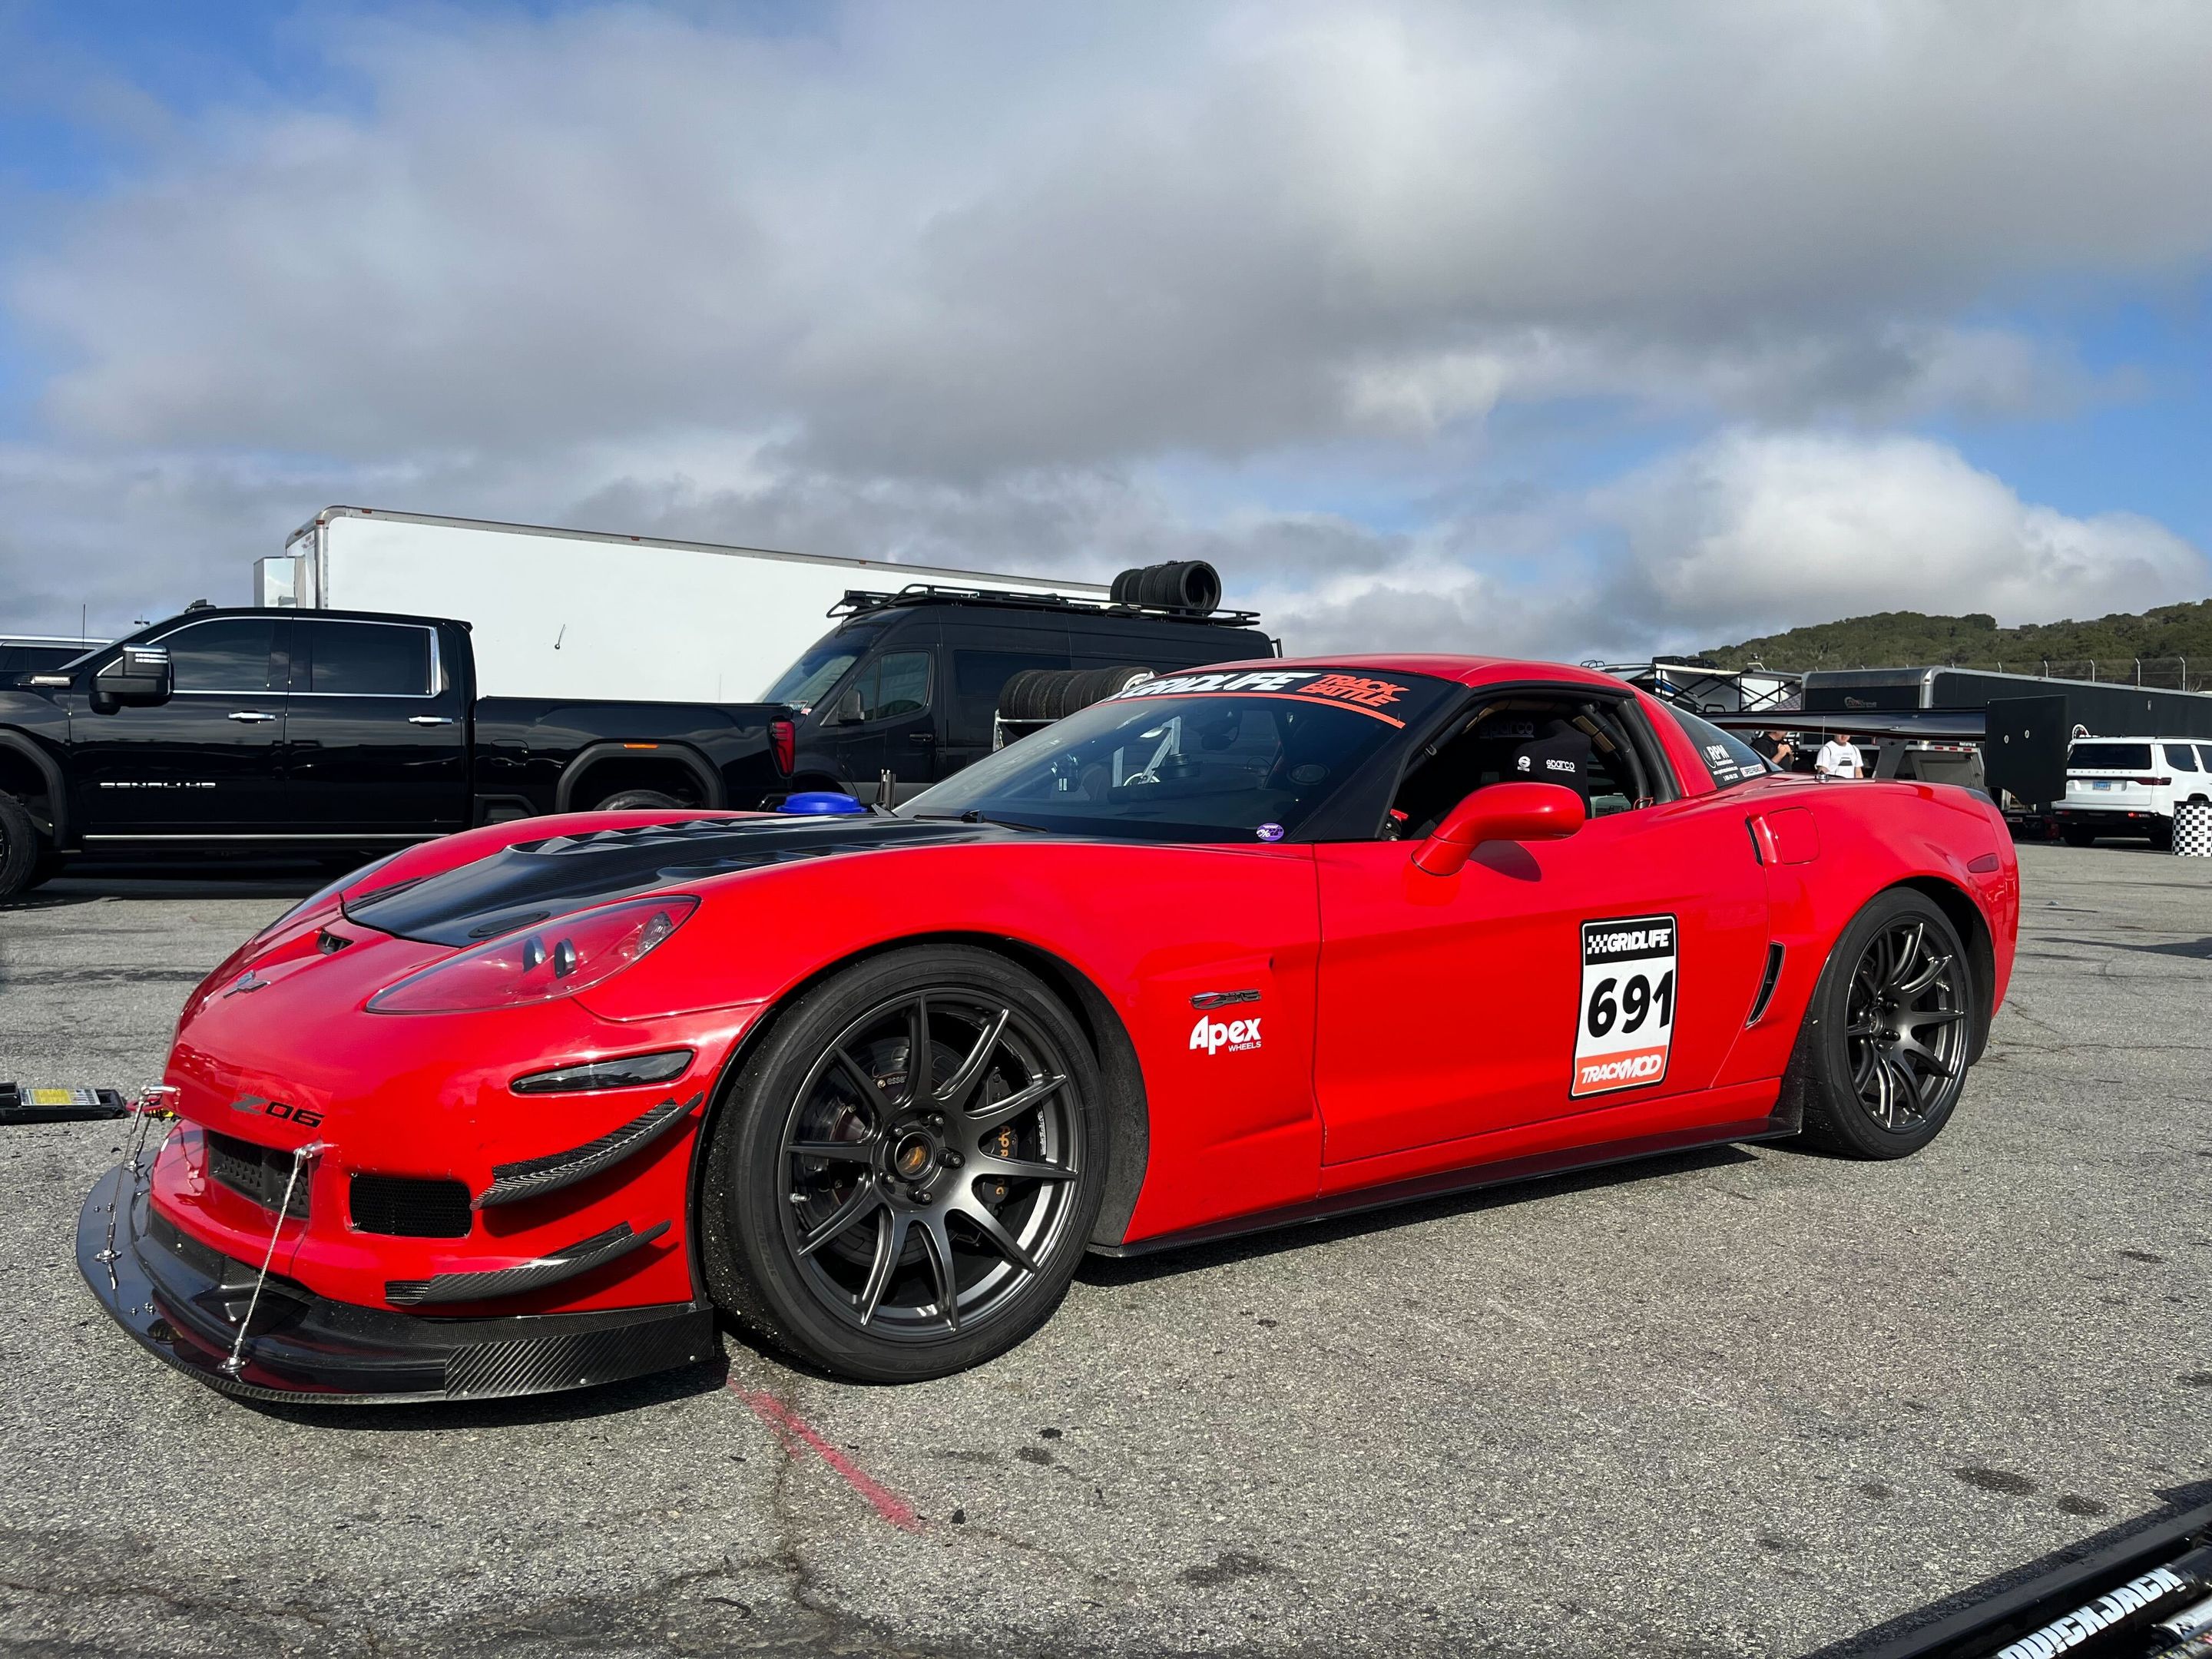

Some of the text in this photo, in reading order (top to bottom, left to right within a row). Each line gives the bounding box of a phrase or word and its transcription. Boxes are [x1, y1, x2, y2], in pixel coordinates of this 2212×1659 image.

[1120, 672, 1321, 698] GRIDLIFE
[1296, 683, 1401, 707] BATTLE
[1316, 674, 1410, 696] TRACK
[1706, 744, 1730, 760] RPM
[1545, 759, 1575, 771] sparco
[1607, 928, 1672, 952] GRIDLIFE
[1588, 969, 1674, 1038] 691
[1189, 1015, 1262, 1055] Apex
[1228, 1041, 1262, 1052] WHEELS
[1581, 1055, 1662, 1084] TRACKMOD
[230, 1093, 326, 1128] Z06
